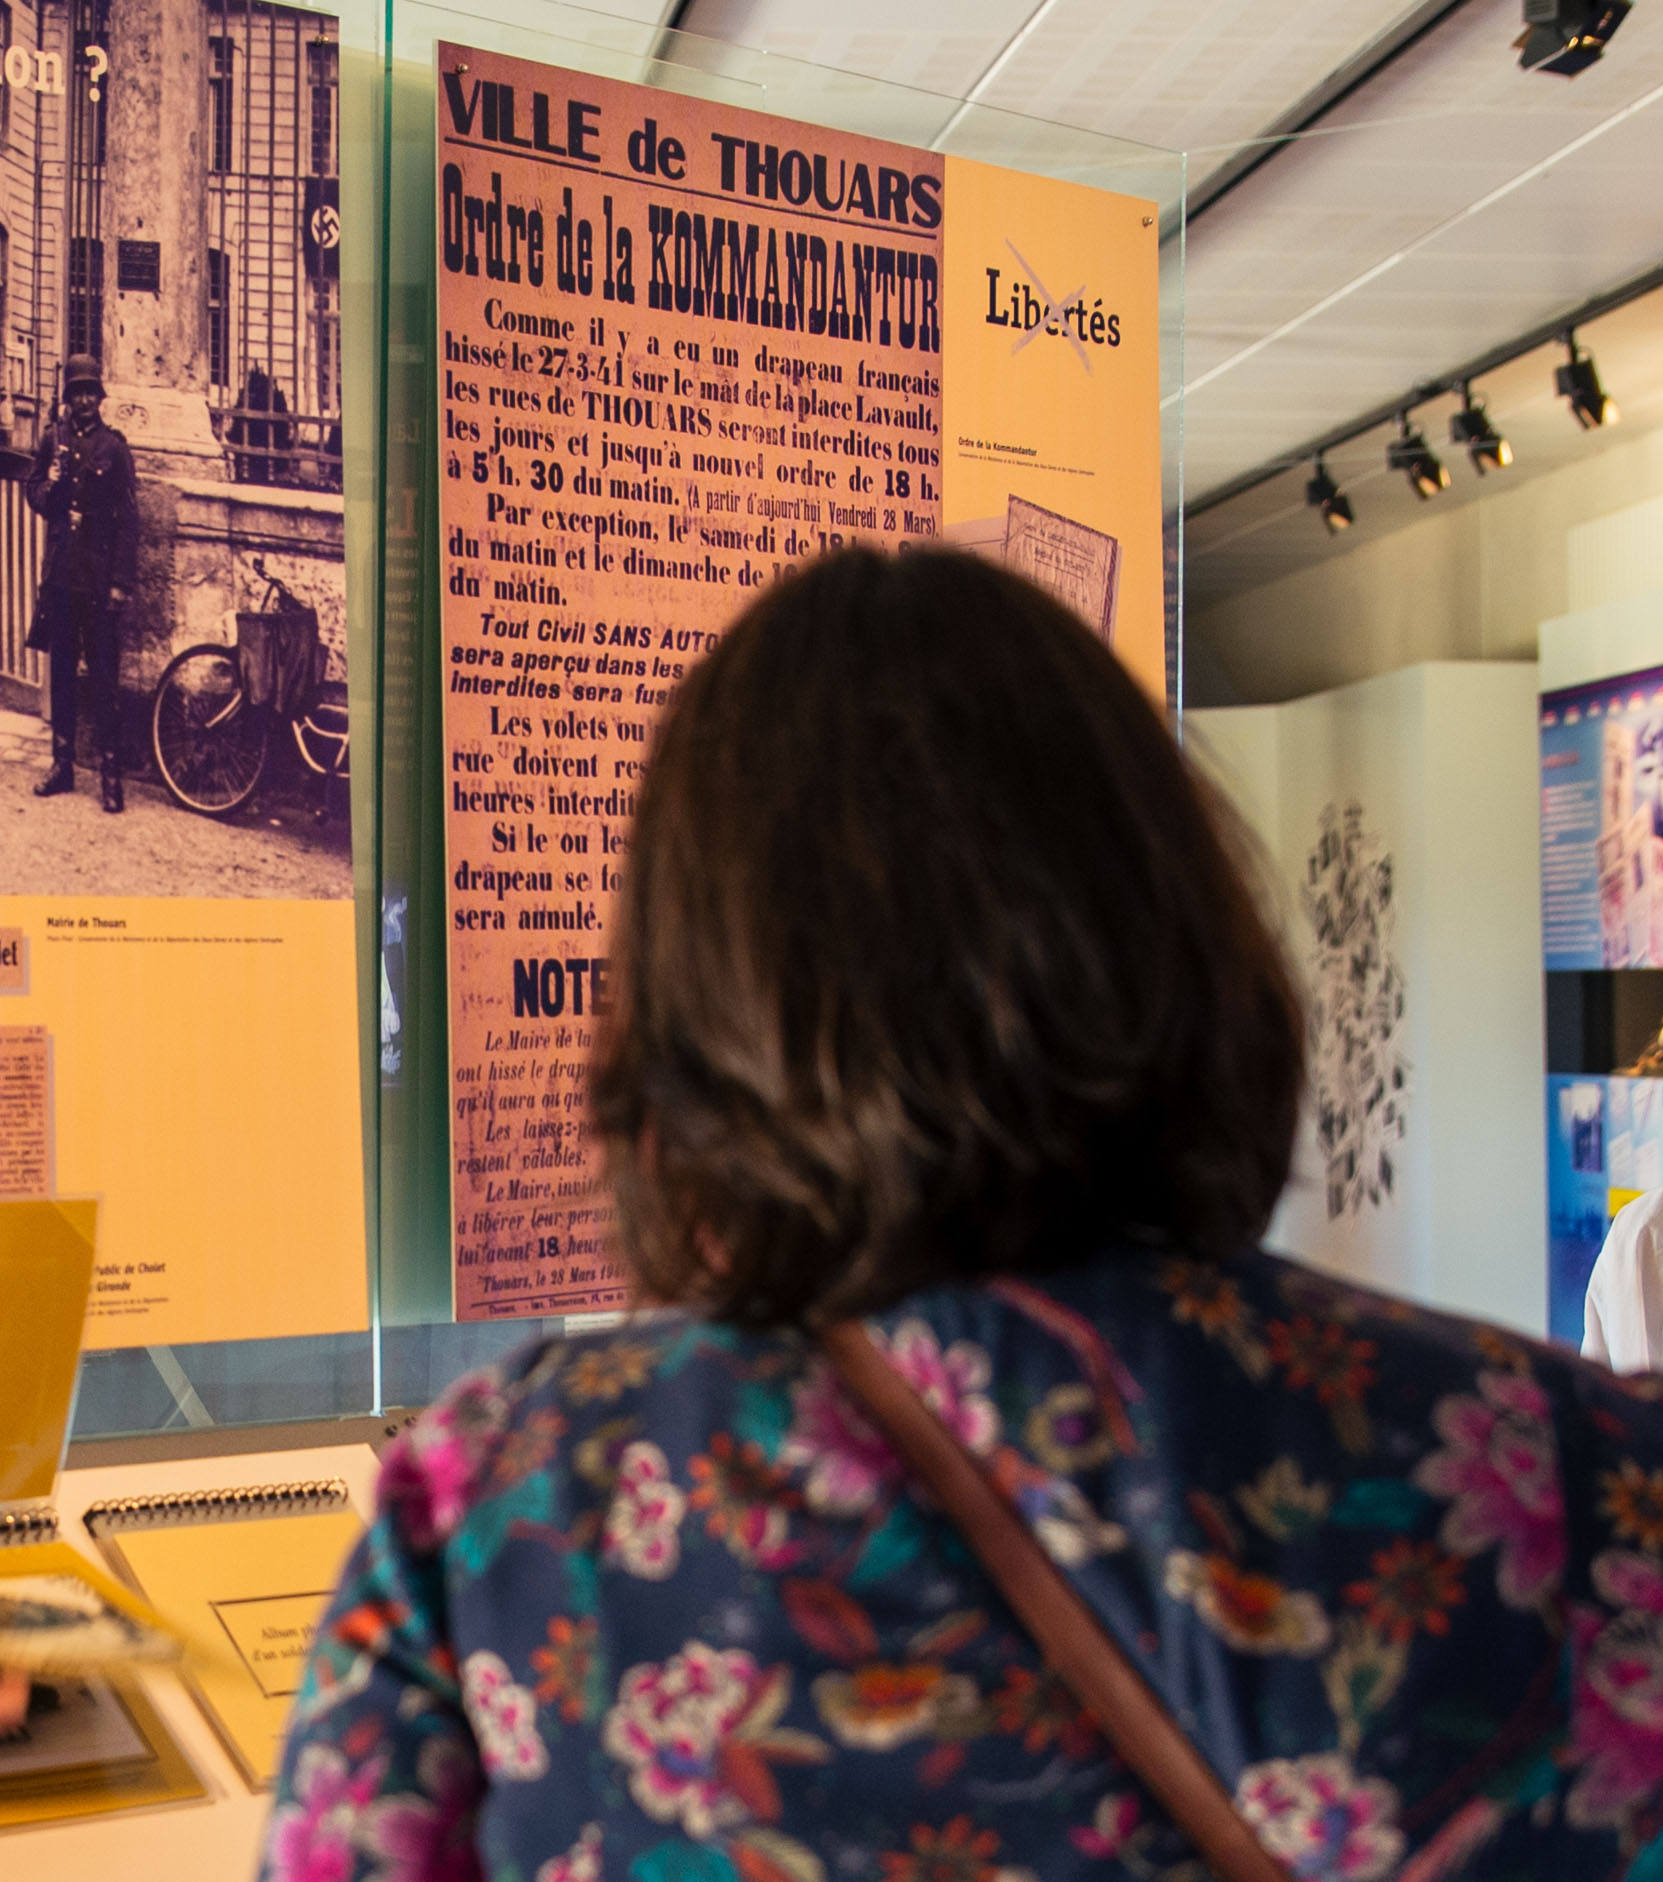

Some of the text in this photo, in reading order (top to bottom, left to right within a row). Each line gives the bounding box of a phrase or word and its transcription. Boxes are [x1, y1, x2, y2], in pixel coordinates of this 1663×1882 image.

[85, 45, 108, 102] ?
[443, 72, 942, 229] VILLE de THOUARS
[443, 162, 940, 353] Ordre de la KOMMANDANTUR
[986, 267, 1121, 347] Libertés
[485, 298, 940, 402] Comme il y a eu un drapeau français
[445, 330, 506, 369] hissé
[512, 342, 533, 374] le
[632, 369, 669, 394] sur
[674, 368, 693, 397] le
[700, 379, 739, 405] mât
[745, 380, 772, 409] de
[775, 383, 794, 413] la
[798, 388, 853, 424] place
[856, 395, 939, 436] Lavault,
[445, 370, 480, 403] les
[489, 385, 542, 414] rues
[547, 385, 576, 417] de
[582, 391, 712, 437] THOUARS
[718, 418, 786, 447] seront
[791, 423, 892, 462] interdites
[898, 440, 940, 467] tous
[446, 409, 480, 443] les
[490, 416, 555, 455] jours
[567, 432, 589, 457] et
[601, 432, 681, 474] jusqu'à
[693, 453, 764, 479] nouvel
[776, 460, 836, 489] ordre
[849, 466, 874, 494] de
[885, 469, 910, 498] 18
[921, 473, 939, 501] h.
[447, 450, 461, 479] à
[472, 450, 488, 483] 5
[498, 455, 520, 487] h.
[531, 459, 564, 493] 30
[573, 466, 602, 497] du
[610, 477, 679, 506] matin.
[706, 490, 741, 514] partir
[747, 492, 821, 523] d'aujourd'hui
[828, 501, 876, 529] Vendredi
[883, 509, 896, 532] 28
[488, 493, 810, 557] Par exception, le samedi de
[449, 528, 479, 559] du
[490, 539, 556, 567] matin
[565, 549, 586, 570] et
[594, 544, 614, 573] le
[623, 547, 731, 584] dimanche
[738, 560, 763, 587] de
[449, 567, 567, 606] du matin.
[481, 613, 529, 640] Tout
[537, 619, 585, 644] Civil
[593, 622, 651, 649] SANS
[450, 645, 684, 680] sera aperçu dans les
[451, 670, 622, 703] interdites sera
[490, 706, 645, 742] Les volets ou
[452, 746, 598, 778] rue doivent
[453, 781, 535, 814] heures
[492, 821, 588, 854] Si le ou
[454, 860, 589, 901] drapeau se
[47, 917, 127, 929] Mairie de Thouars
[454, 901, 603, 932] sera annulé.
[486, 1027, 572, 1052] Le Maire de
[456, 1059, 543, 1083] ont hissé le
[499, 1092, 560, 1111] aura ou
[486, 1120, 511, 1143] Les
[457, 1151, 511, 1174] restent
[487, 1181, 504, 1203] Le
[472, 1207, 563, 1235] libérer leur
[538, 1236, 560, 1259] 18
[536, 1270, 546, 1286] le
[550, 1269, 565, 1285] 28
[568, 1266, 596, 1284] Mars
